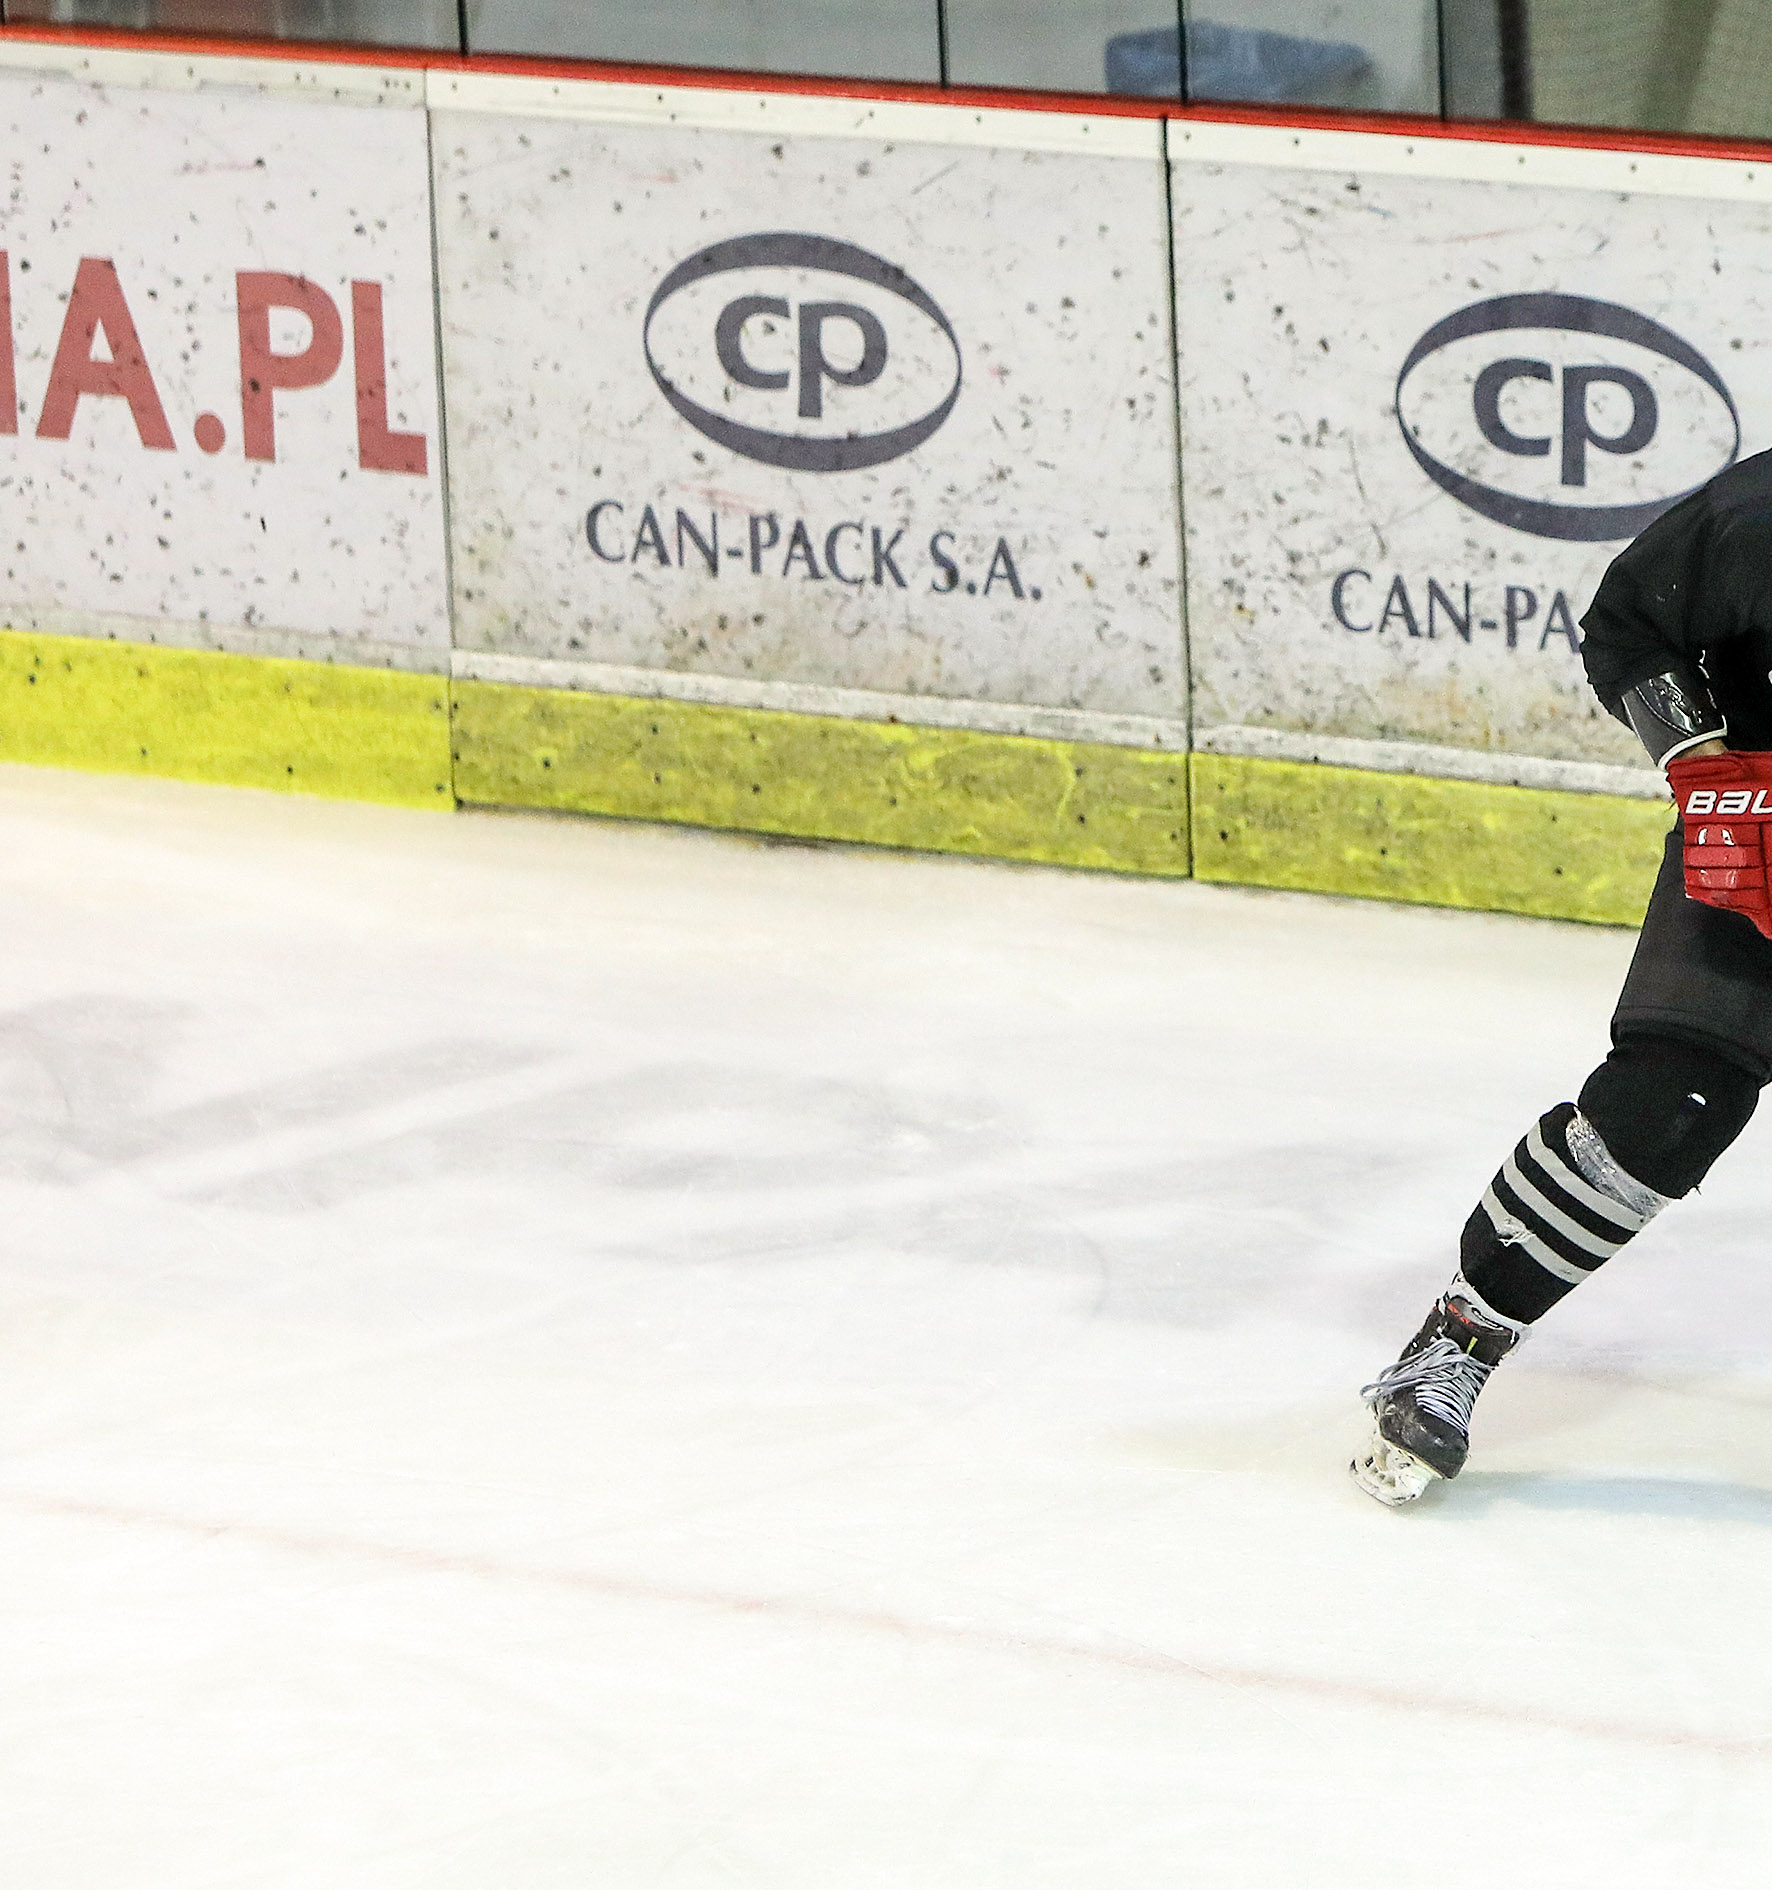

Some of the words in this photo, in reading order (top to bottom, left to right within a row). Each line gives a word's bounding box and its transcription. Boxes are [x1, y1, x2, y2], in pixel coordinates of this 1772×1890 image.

[585, 500, 907, 588] CAN-PACK
[929, 530, 1043, 601] S.A.
[1331, 569, 1582, 654] CAN-PA
